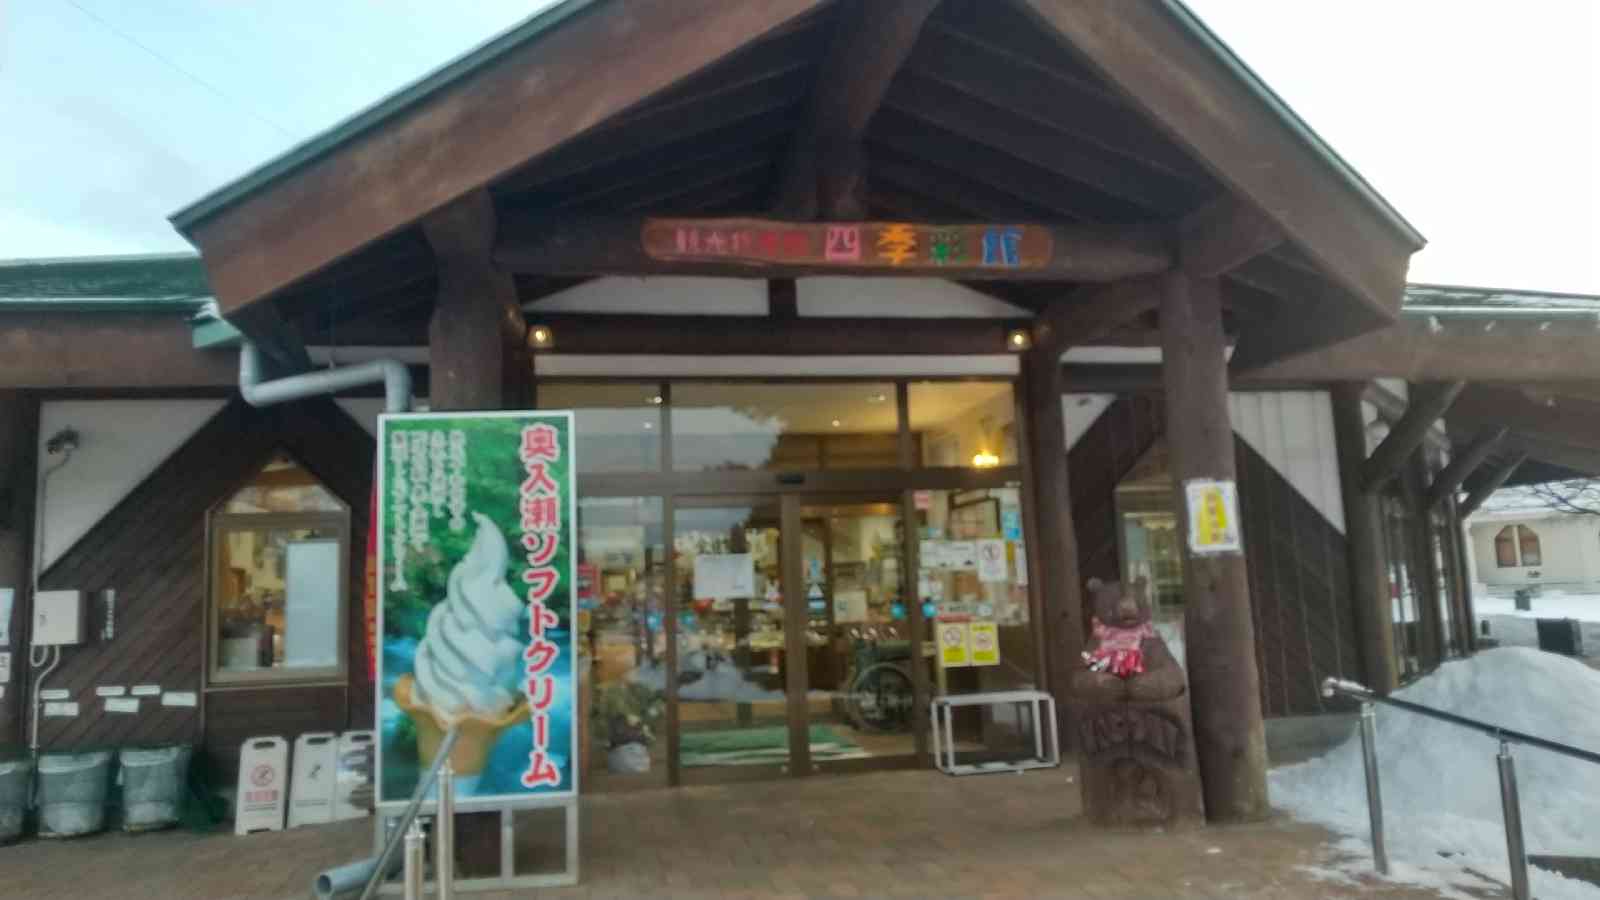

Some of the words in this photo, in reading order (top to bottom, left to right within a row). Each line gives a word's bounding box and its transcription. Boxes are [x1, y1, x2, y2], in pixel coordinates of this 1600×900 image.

[520, 424, 562, 790] 奥入瀬ソフトクリーム
